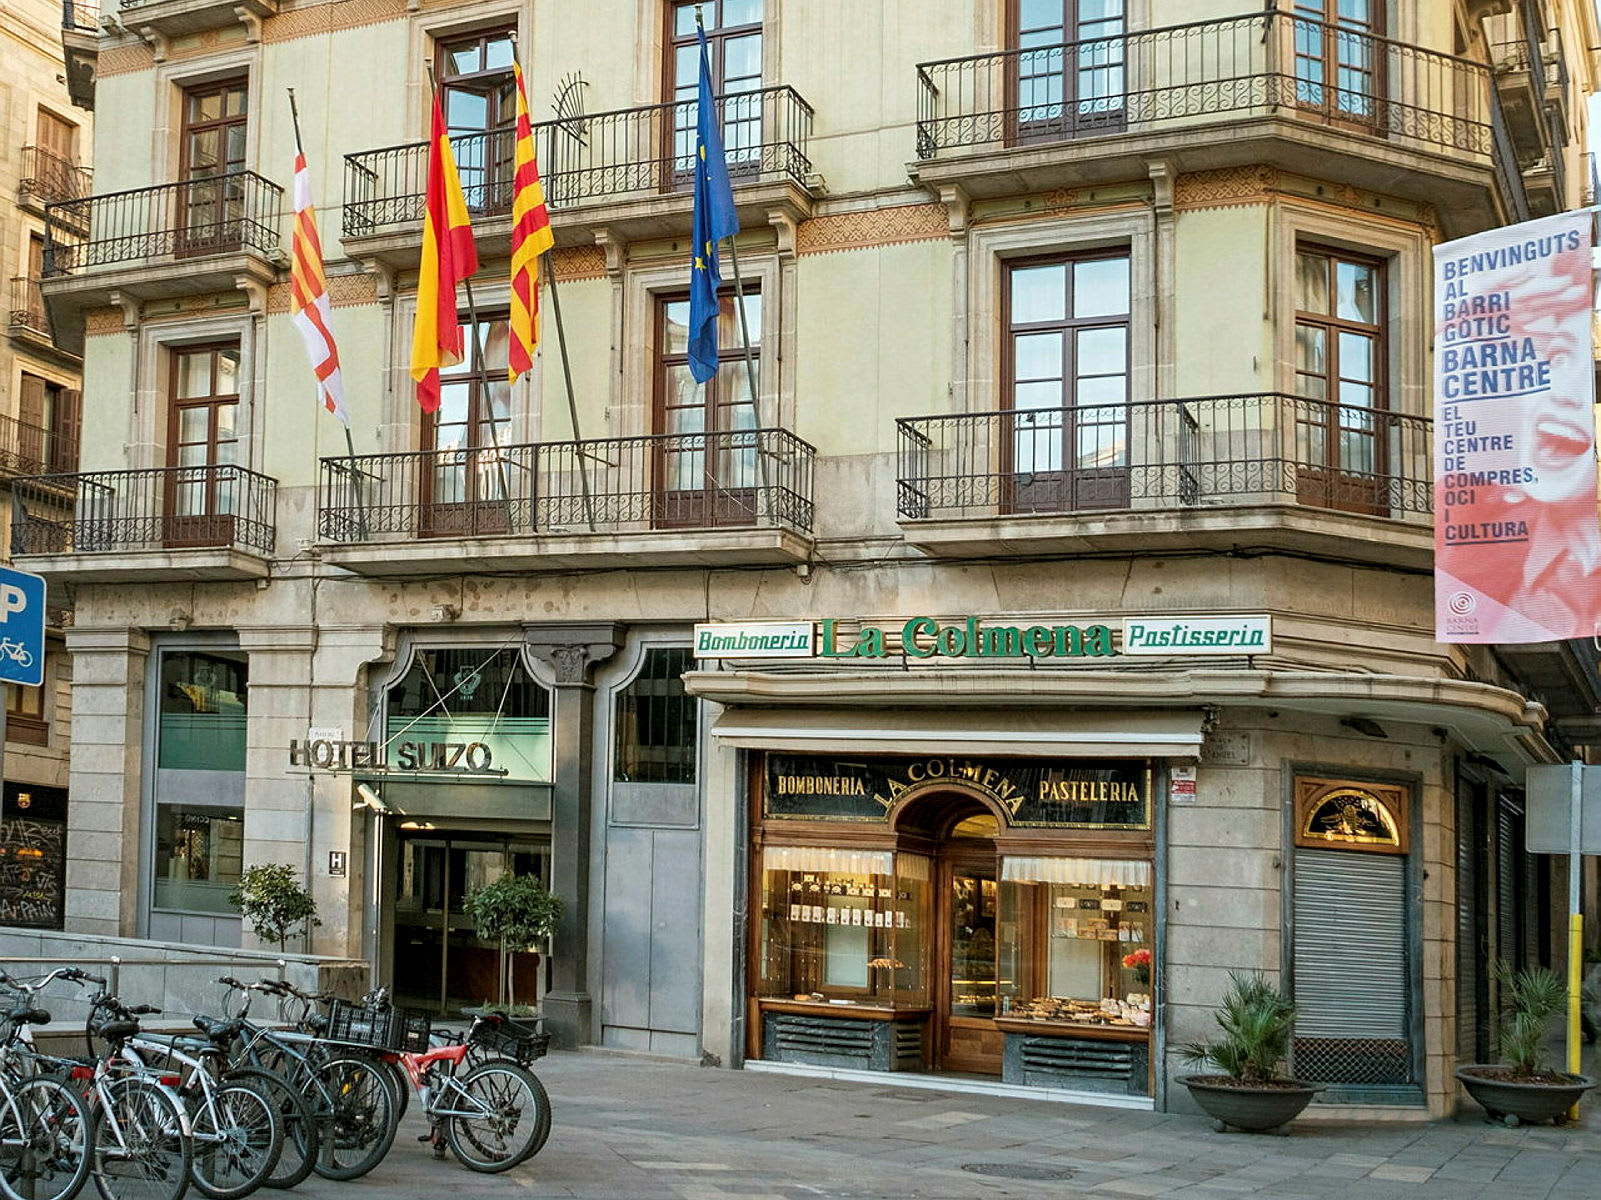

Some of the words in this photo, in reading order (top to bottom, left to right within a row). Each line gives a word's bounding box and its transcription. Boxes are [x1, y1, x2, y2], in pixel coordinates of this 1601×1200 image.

[1443, 230, 1580, 281] BENVINGUTS
[1445, 280, 1468, 301] AL
[1444, 291, 1511, 321] BARRI
[1444, 313, 1511, 342] GÒTIC
[1444, 337, 1537, 373] BARNA
[1444, 360, 1551, 399] CENTRE
[1444, 406, 1463, 421] EL
[1444, 421, 1476, 438] TEU
[1444, 435, 1513, 455] CENTRE
[1444, 456, 1466, 471] DE
[1444, 490, 1475, 506] OCI
[1444, 508, 1450, 522] I
[1445, 521, 1529, 540] CULTURA
[0, 583, 27, 623] P
[698, 630, 809, 651] Bomboneria
[820, 618, 887, 657] La
[901, 616, 1117, 658] Colmena
[1128, 624, 1264, 648] Pastisseria
[289, 739, 389, 769] HOTEL
[397, 740, 493, 772] SUIZO
[777, 775, 866, 796] BOMBONERIA
[873, 777, 908, 808] LA
[907, 758, 1025, 816] COLMENA
[1039, 780, 1140, 803] PASTELERIA
[331, 853, 342, 869] H
